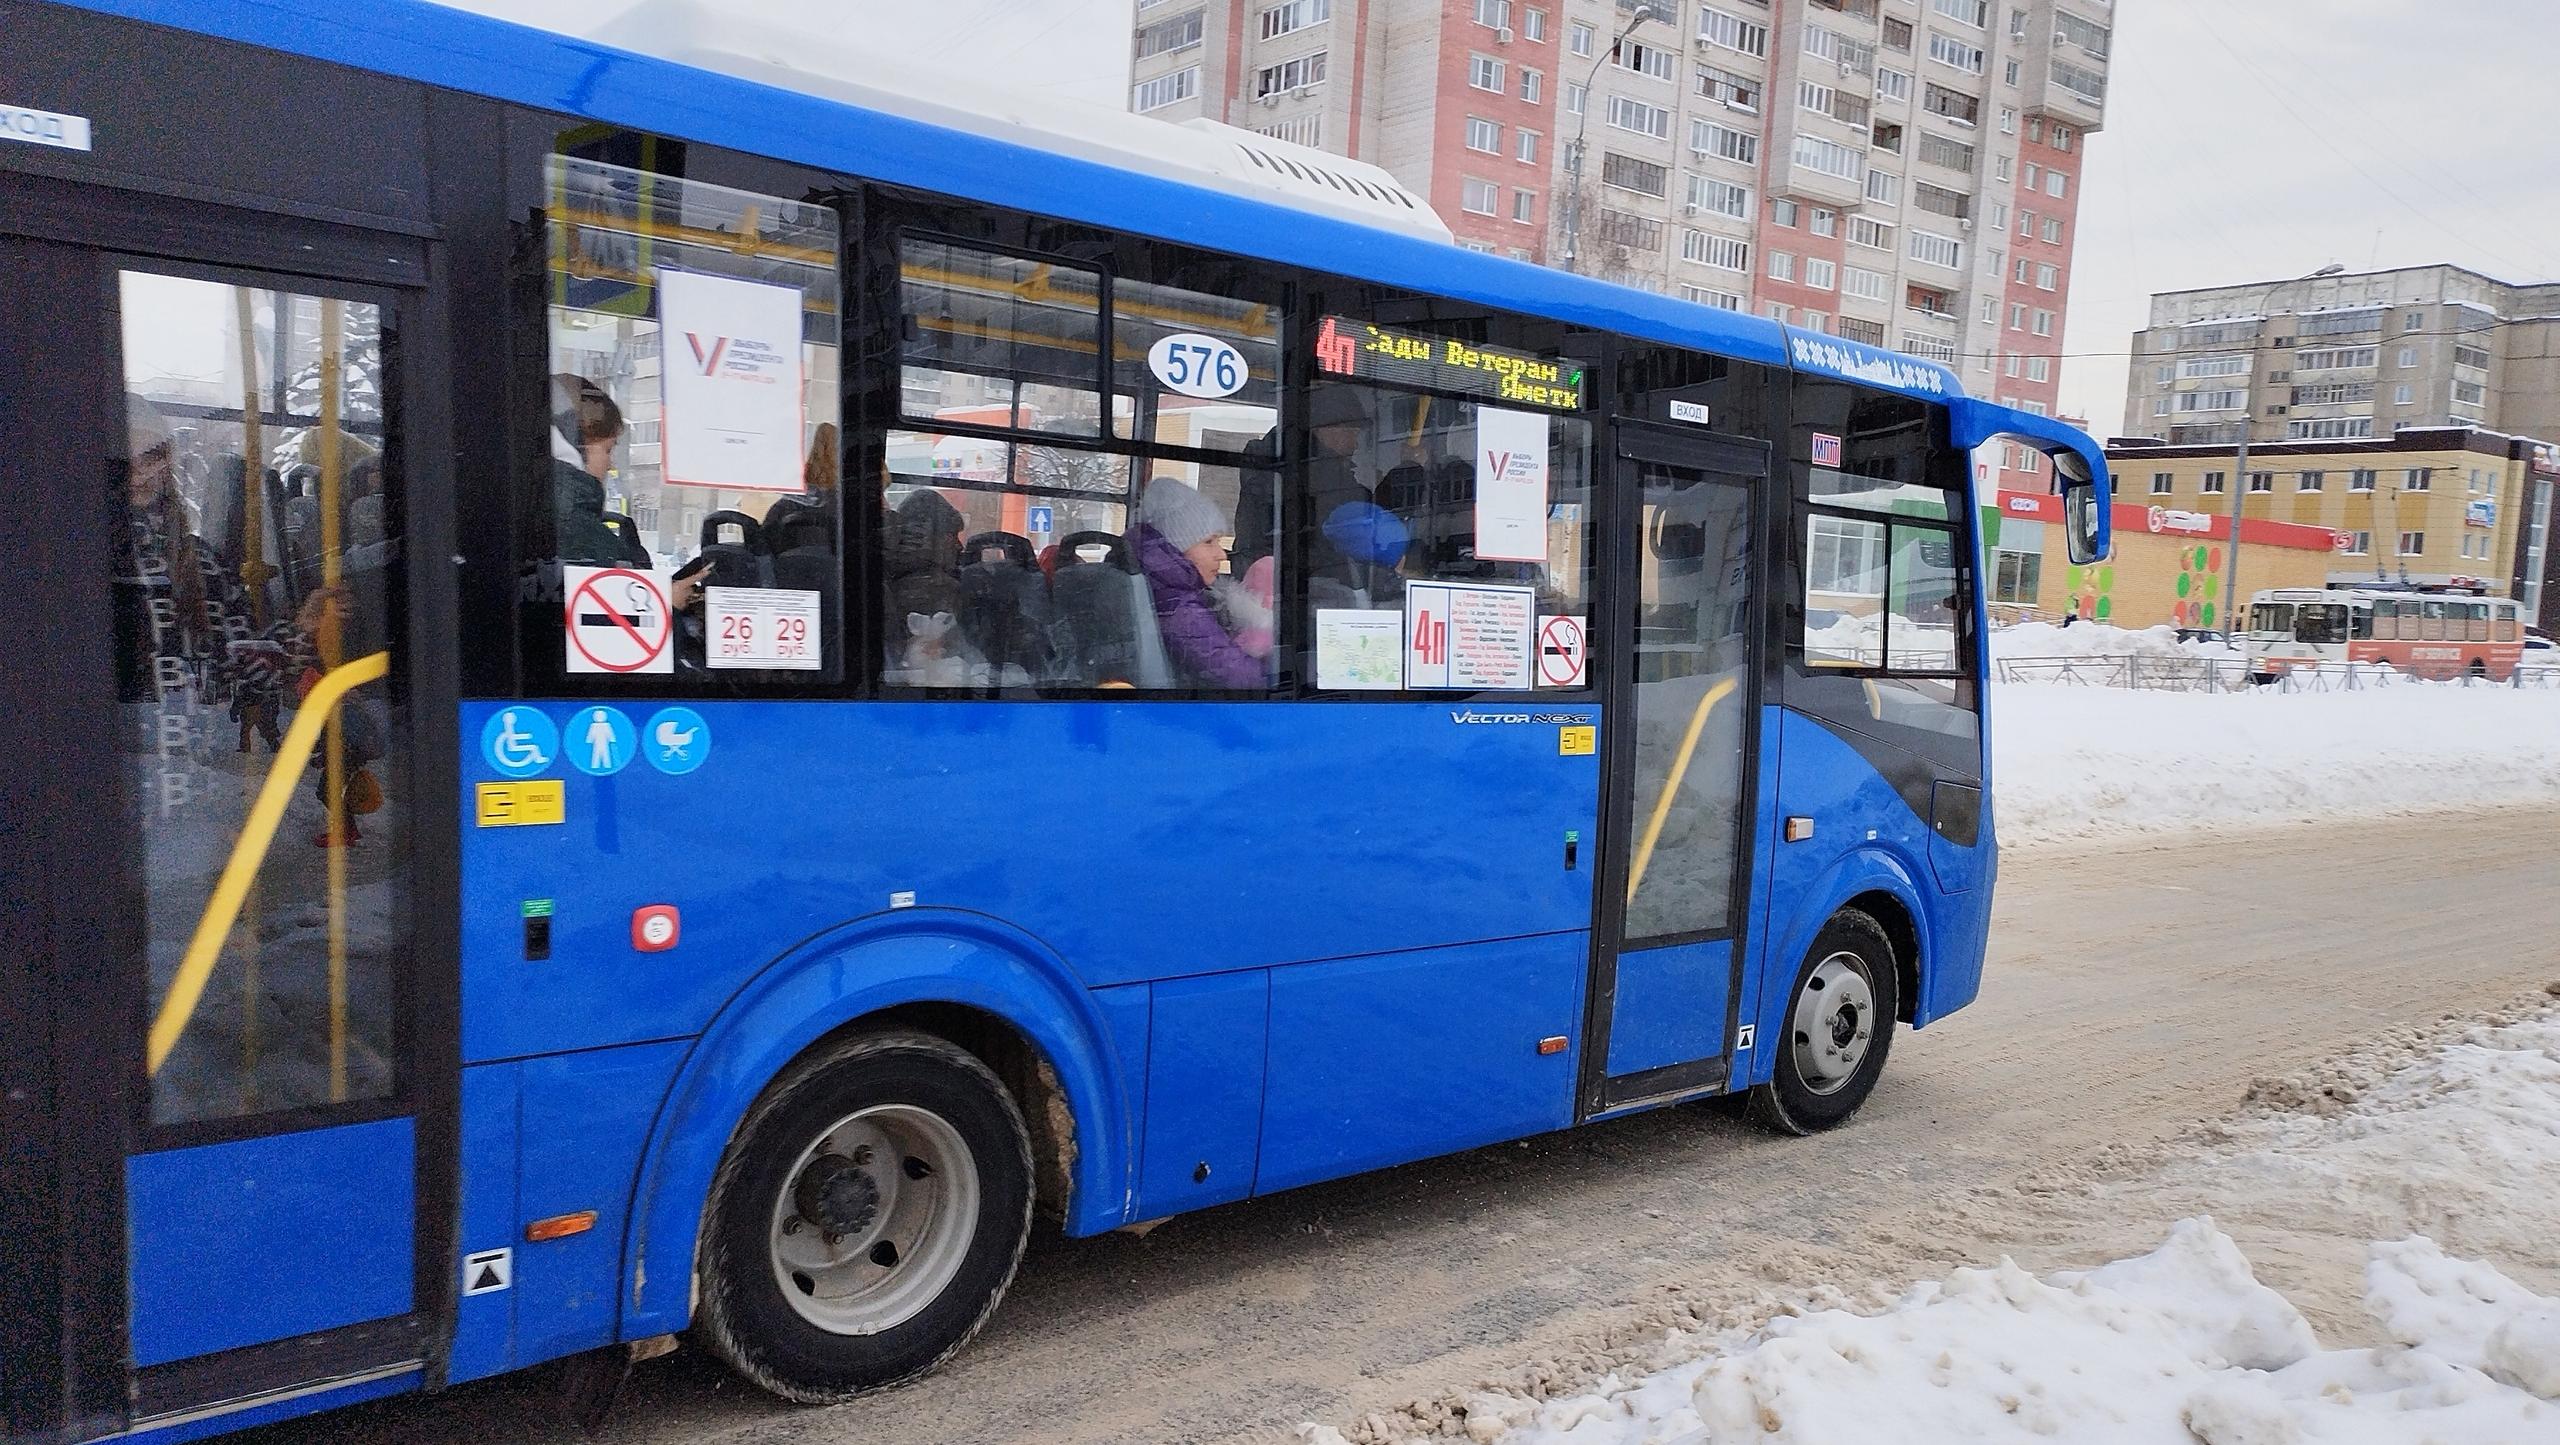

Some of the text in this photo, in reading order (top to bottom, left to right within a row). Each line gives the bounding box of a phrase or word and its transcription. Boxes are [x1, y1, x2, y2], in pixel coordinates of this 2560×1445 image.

[1167, 342, 1236, 391] 576
[1446, 340, 1558, 382] Ветеран
[1676, 404, 1702, 419] ВХОД
[722, 616, 753, 640] 26
[777, 618, 806, 642] 29
[721, 641, 756, 657] руб.
[776, 643, 810, 658] руб.
